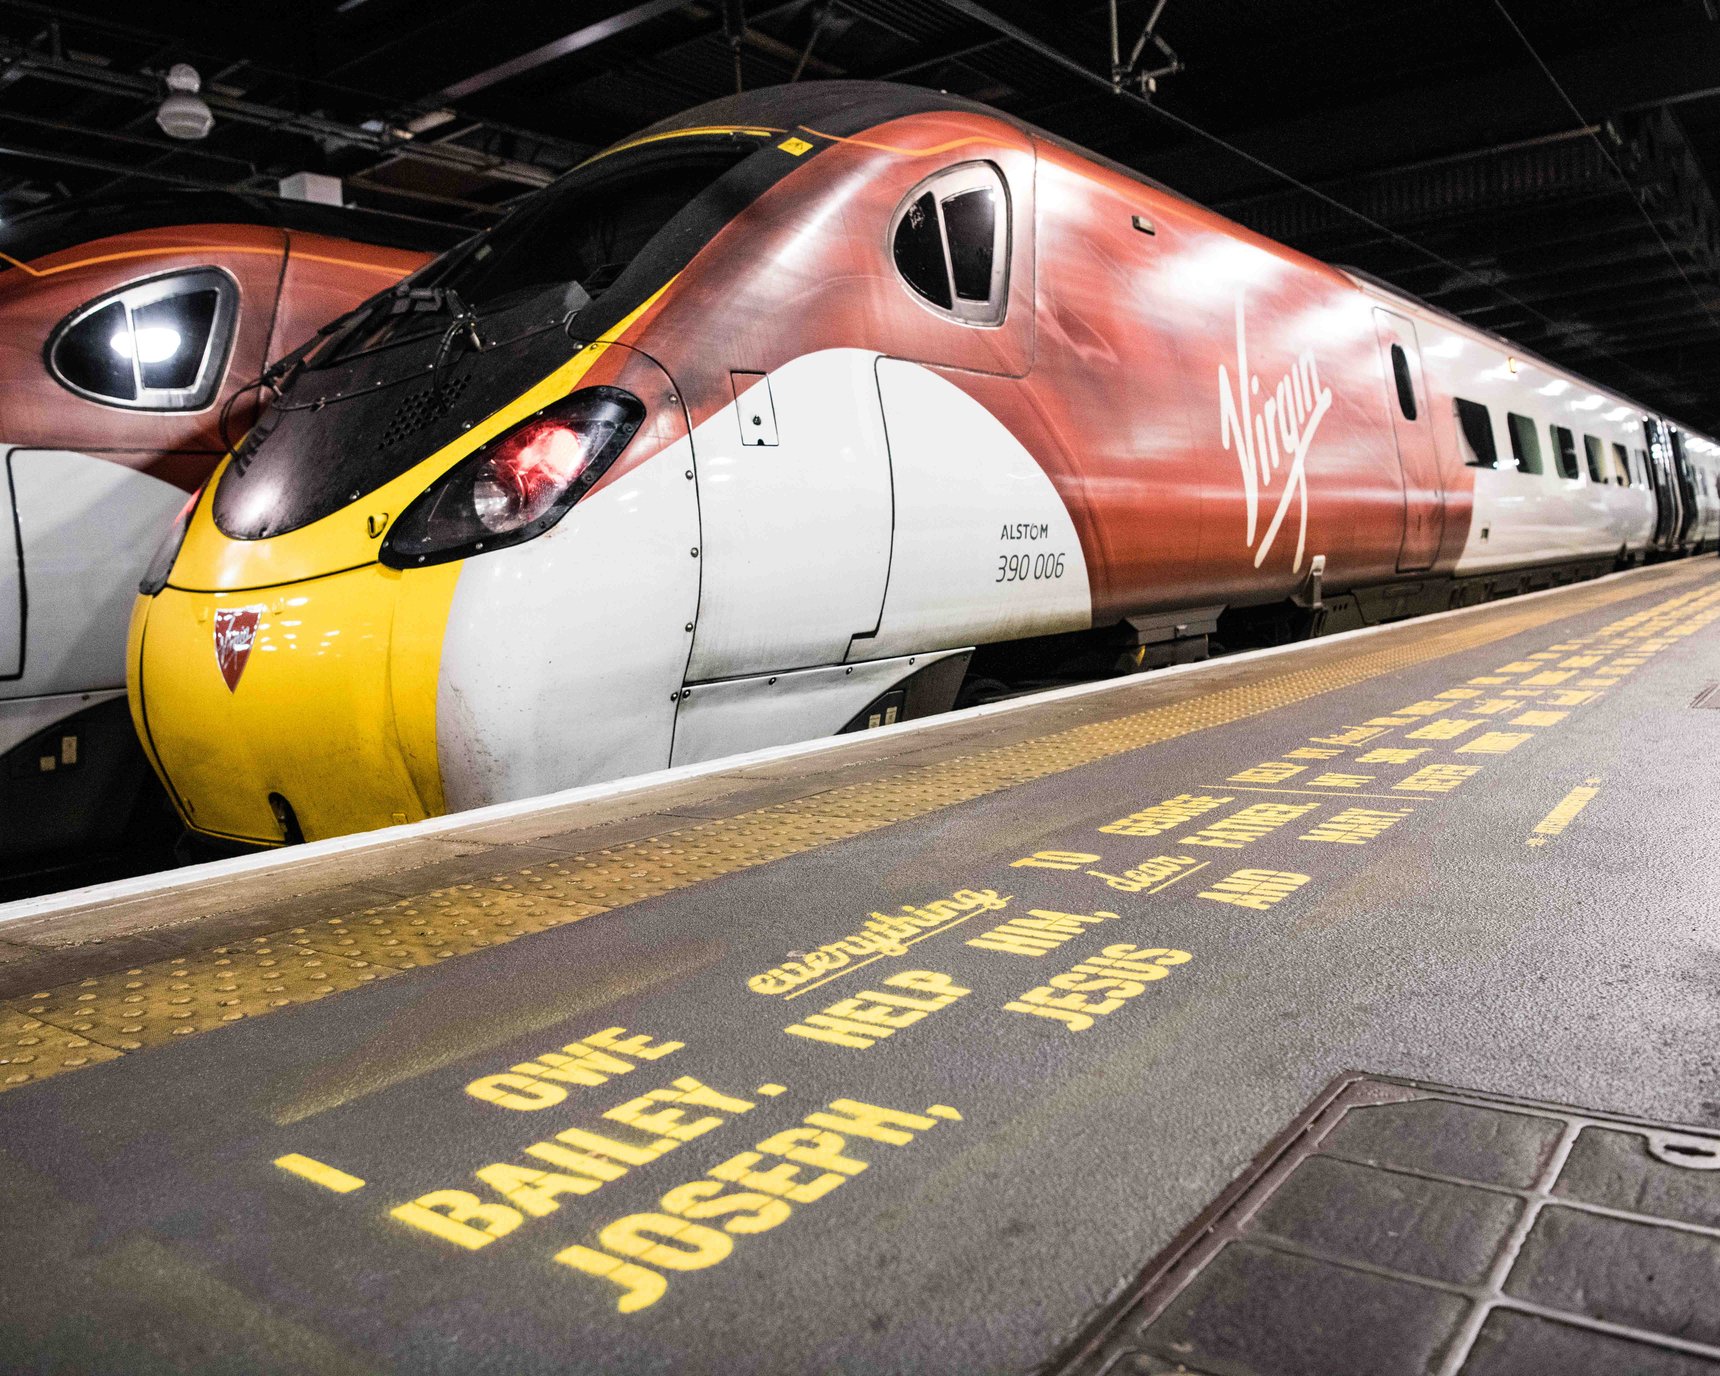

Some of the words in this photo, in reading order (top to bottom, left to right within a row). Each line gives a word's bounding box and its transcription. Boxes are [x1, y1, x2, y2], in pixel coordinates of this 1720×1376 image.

[995, 553, 1030, 583] 390
[1034, 552, 1066, 580] 006
[1000, 522, 1049, 541] ALSTOM
[1218, 284, 1333, 575] Virgin
[274, 1153, 365, 1193] I
[465, 1027, 686, 1111] OWE
[748, 888, 1013, 1000] everything
[1010, 850, 1101, 871] TO
[1098, 794, 1236, 836] GEORGE
[390, 1076, 788, 1249] BAILEY.
[784, 970, 972, 1049] HELP
[966, 909, 1121, 957] HIM,
[1086, 855, 1206, 894] dear
[1178, 802, 1321, 848] FATHER.
[554, 1098, 963, 1313] JOSEPH,
[1003, 944, 1193, 1032] JESUS
[1197, 869, 1312, 910] AND
